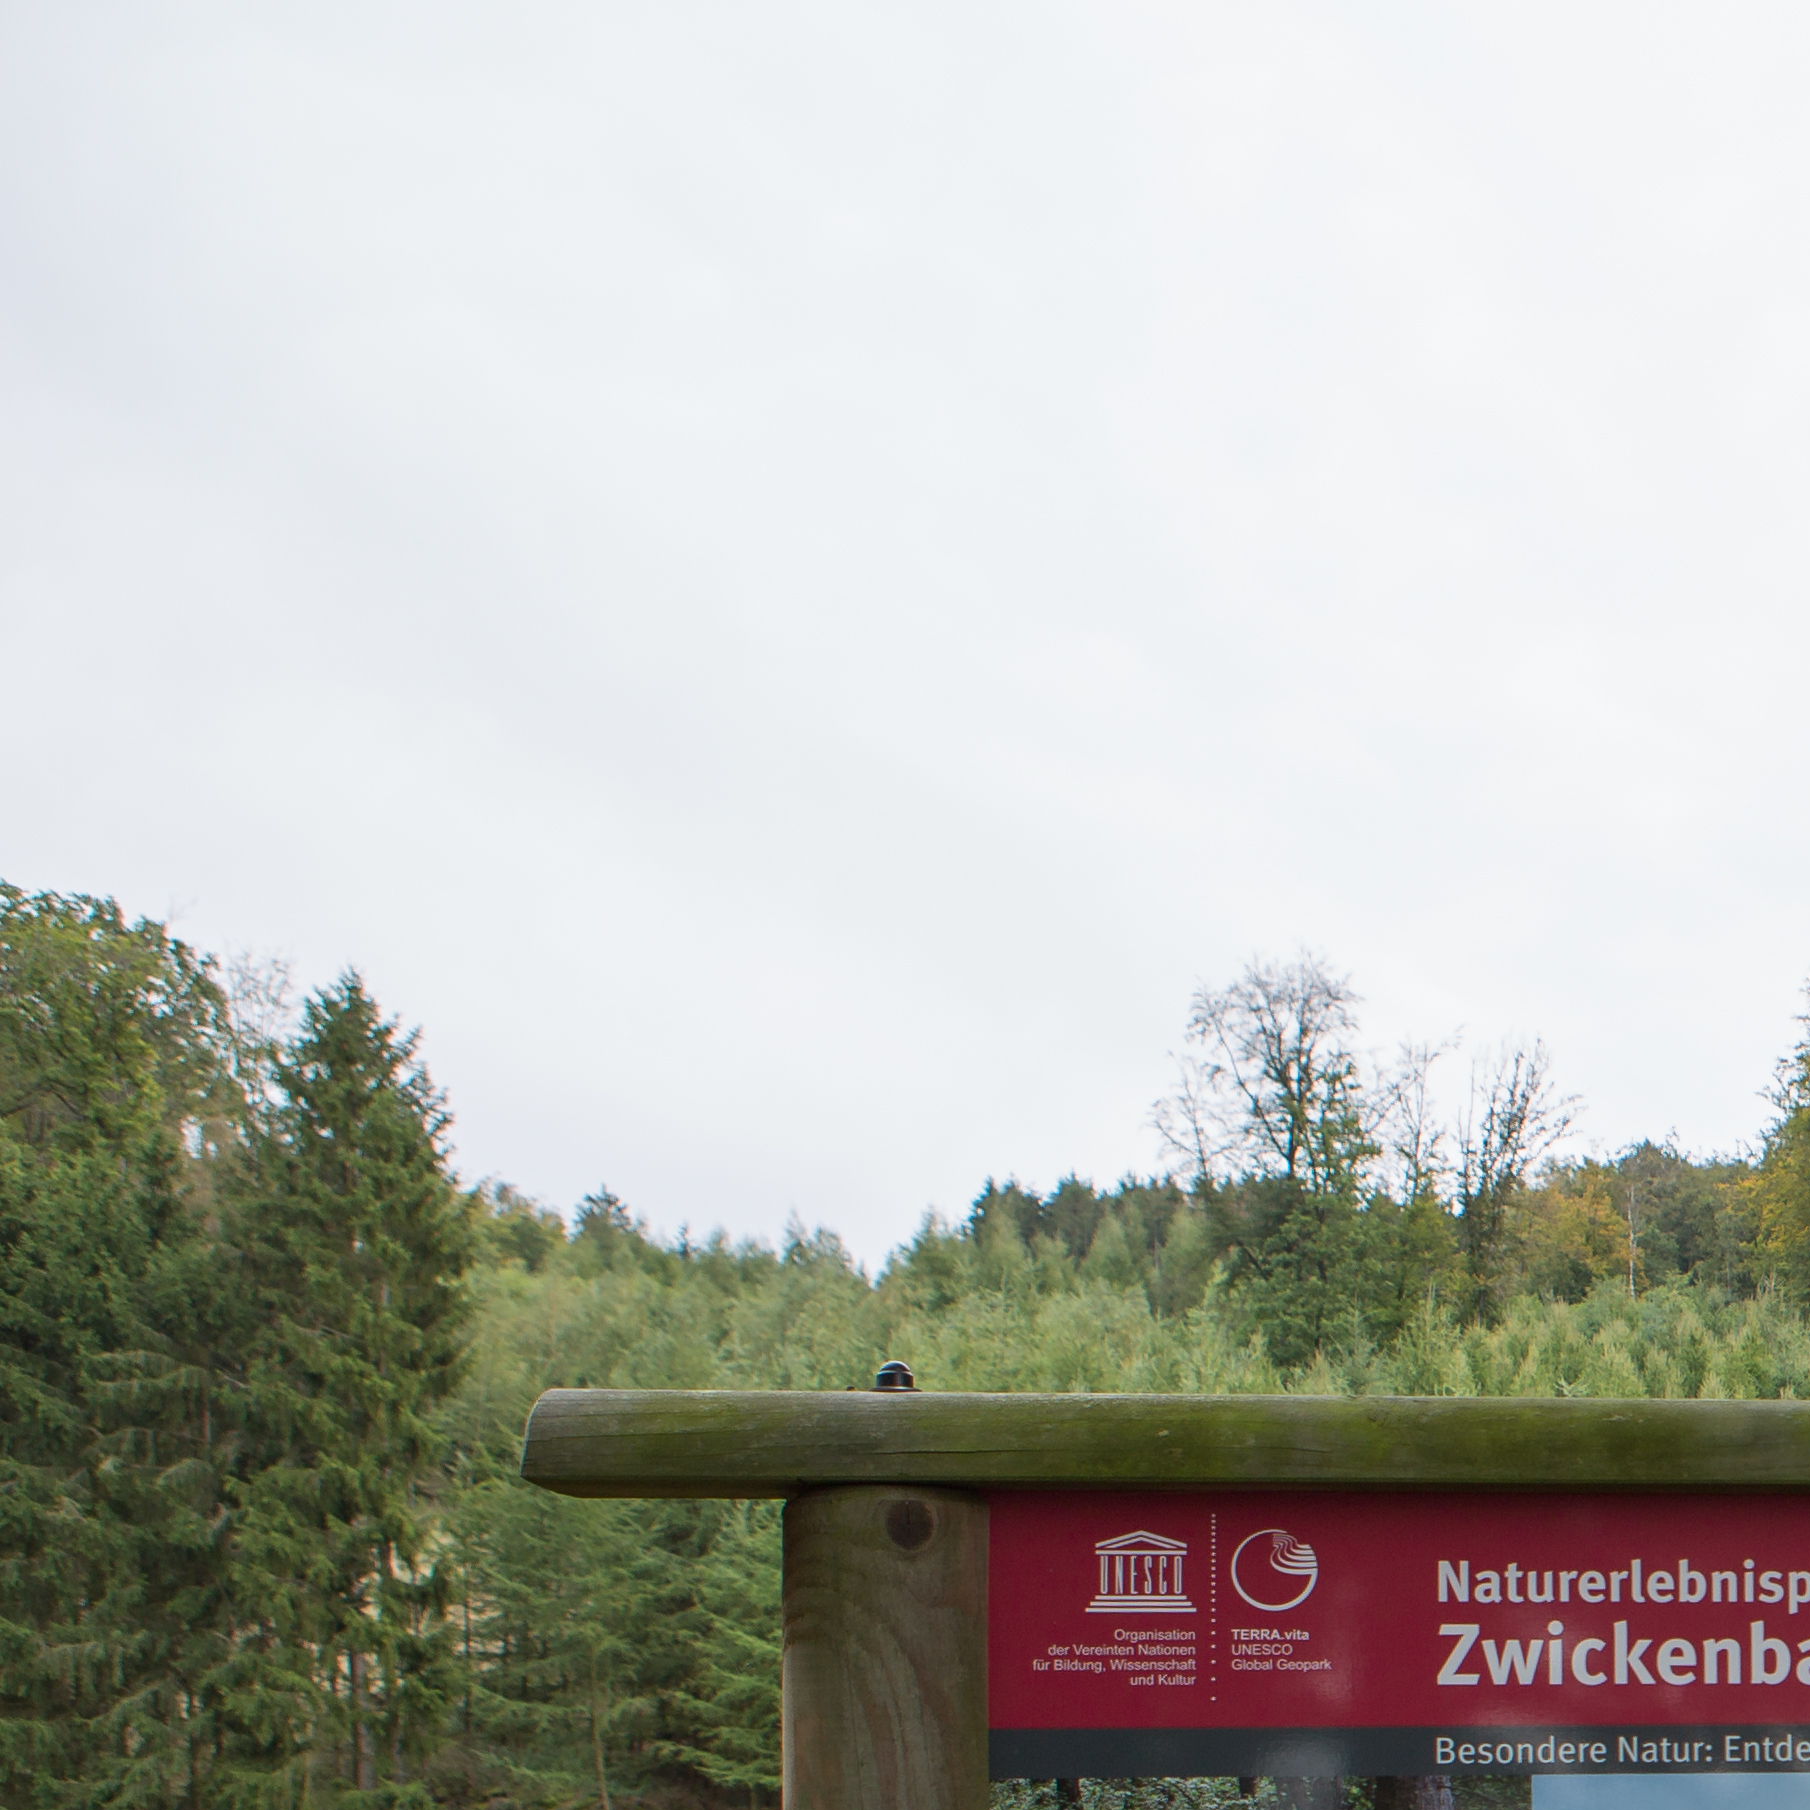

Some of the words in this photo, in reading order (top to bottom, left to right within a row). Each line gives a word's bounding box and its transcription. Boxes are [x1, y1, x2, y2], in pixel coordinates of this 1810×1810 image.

[1100, 1556, 1182, 1594] UNESCO
[1114, 1629, 1196, 1643] Organisation
[1231, 1629, 1309, 1640] TERRA.vita
[1048, 1645, 1069, 1656] der
[1073, 1645, 1134, 1656] Vereinten
[1138, 1645, 1196, 1656] Nationen
[1231, 1644, 1293, 1656] UNESCO
[1033, 1659, 1051, 1671] für
[1054, 1659, 1106, 1673] Bildung,
[1110, 1659, 1196, 1671] Wissenschaft
[1231, 1659, 1273, 1671] Global
[1277, 1659, 1332, 1673] Geopark
[1130, 1675, 1155, 1686] und
[1158, 1675, 1196, 1686] Kultur
[1435, 1735, 1607, 1765] Besondere
[1618, 1735, 1712, 1763] Natur:
